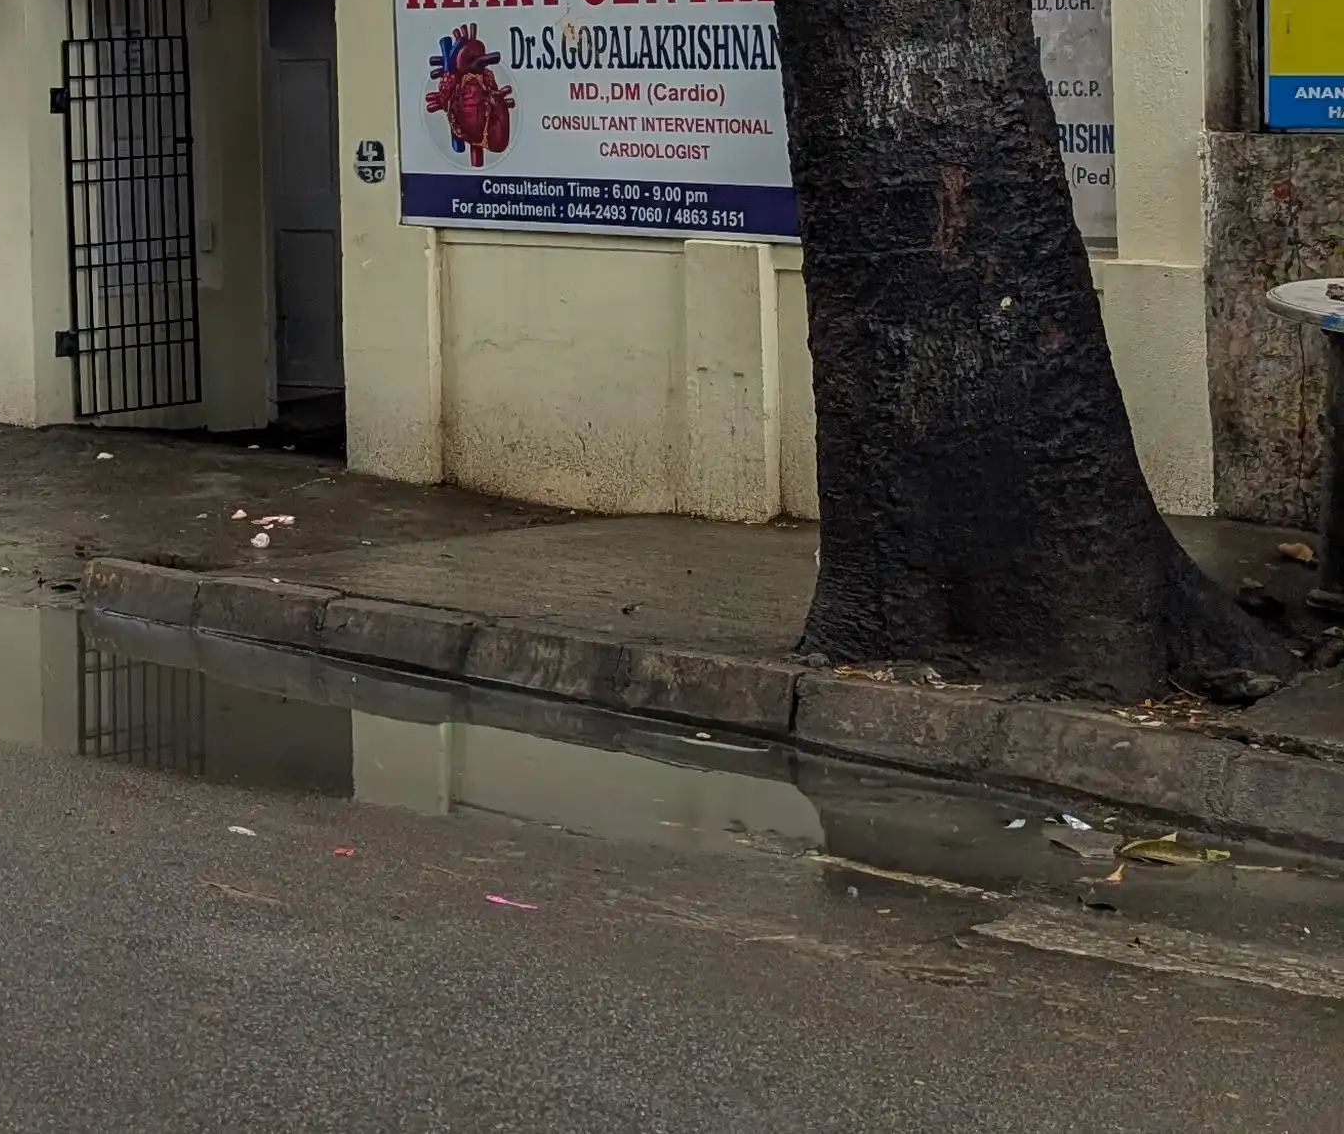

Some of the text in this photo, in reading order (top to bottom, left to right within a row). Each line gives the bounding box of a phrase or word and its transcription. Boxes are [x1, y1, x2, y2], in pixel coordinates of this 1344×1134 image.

[646, 82, 726, 106] (Cardio)
[1294, 86, 1344, 99] ANAN
[541, 115, 773, 136] CONSULTANT INTERVENTIONAL
[359, 142, 378, 160] 4
[599, 142, 710, 161] CARDIOLOGIST
[482, 178, 564, 197] Consultation
[567, 181, 600, 198] Time
[612, 183, 640, 200] 6.00
[653, 185, 681, 202] 9.00
[685, 189, 708, 207] pm
[452, 198, 474, 214] For
[476, 201, 556, 218] appointment
[567, 203, 627, 221] 044-2493
[630, 205, 662, 223] 7060
[674, 208, 708, 225] 4863
[711, 210, 745, 227] 5151
